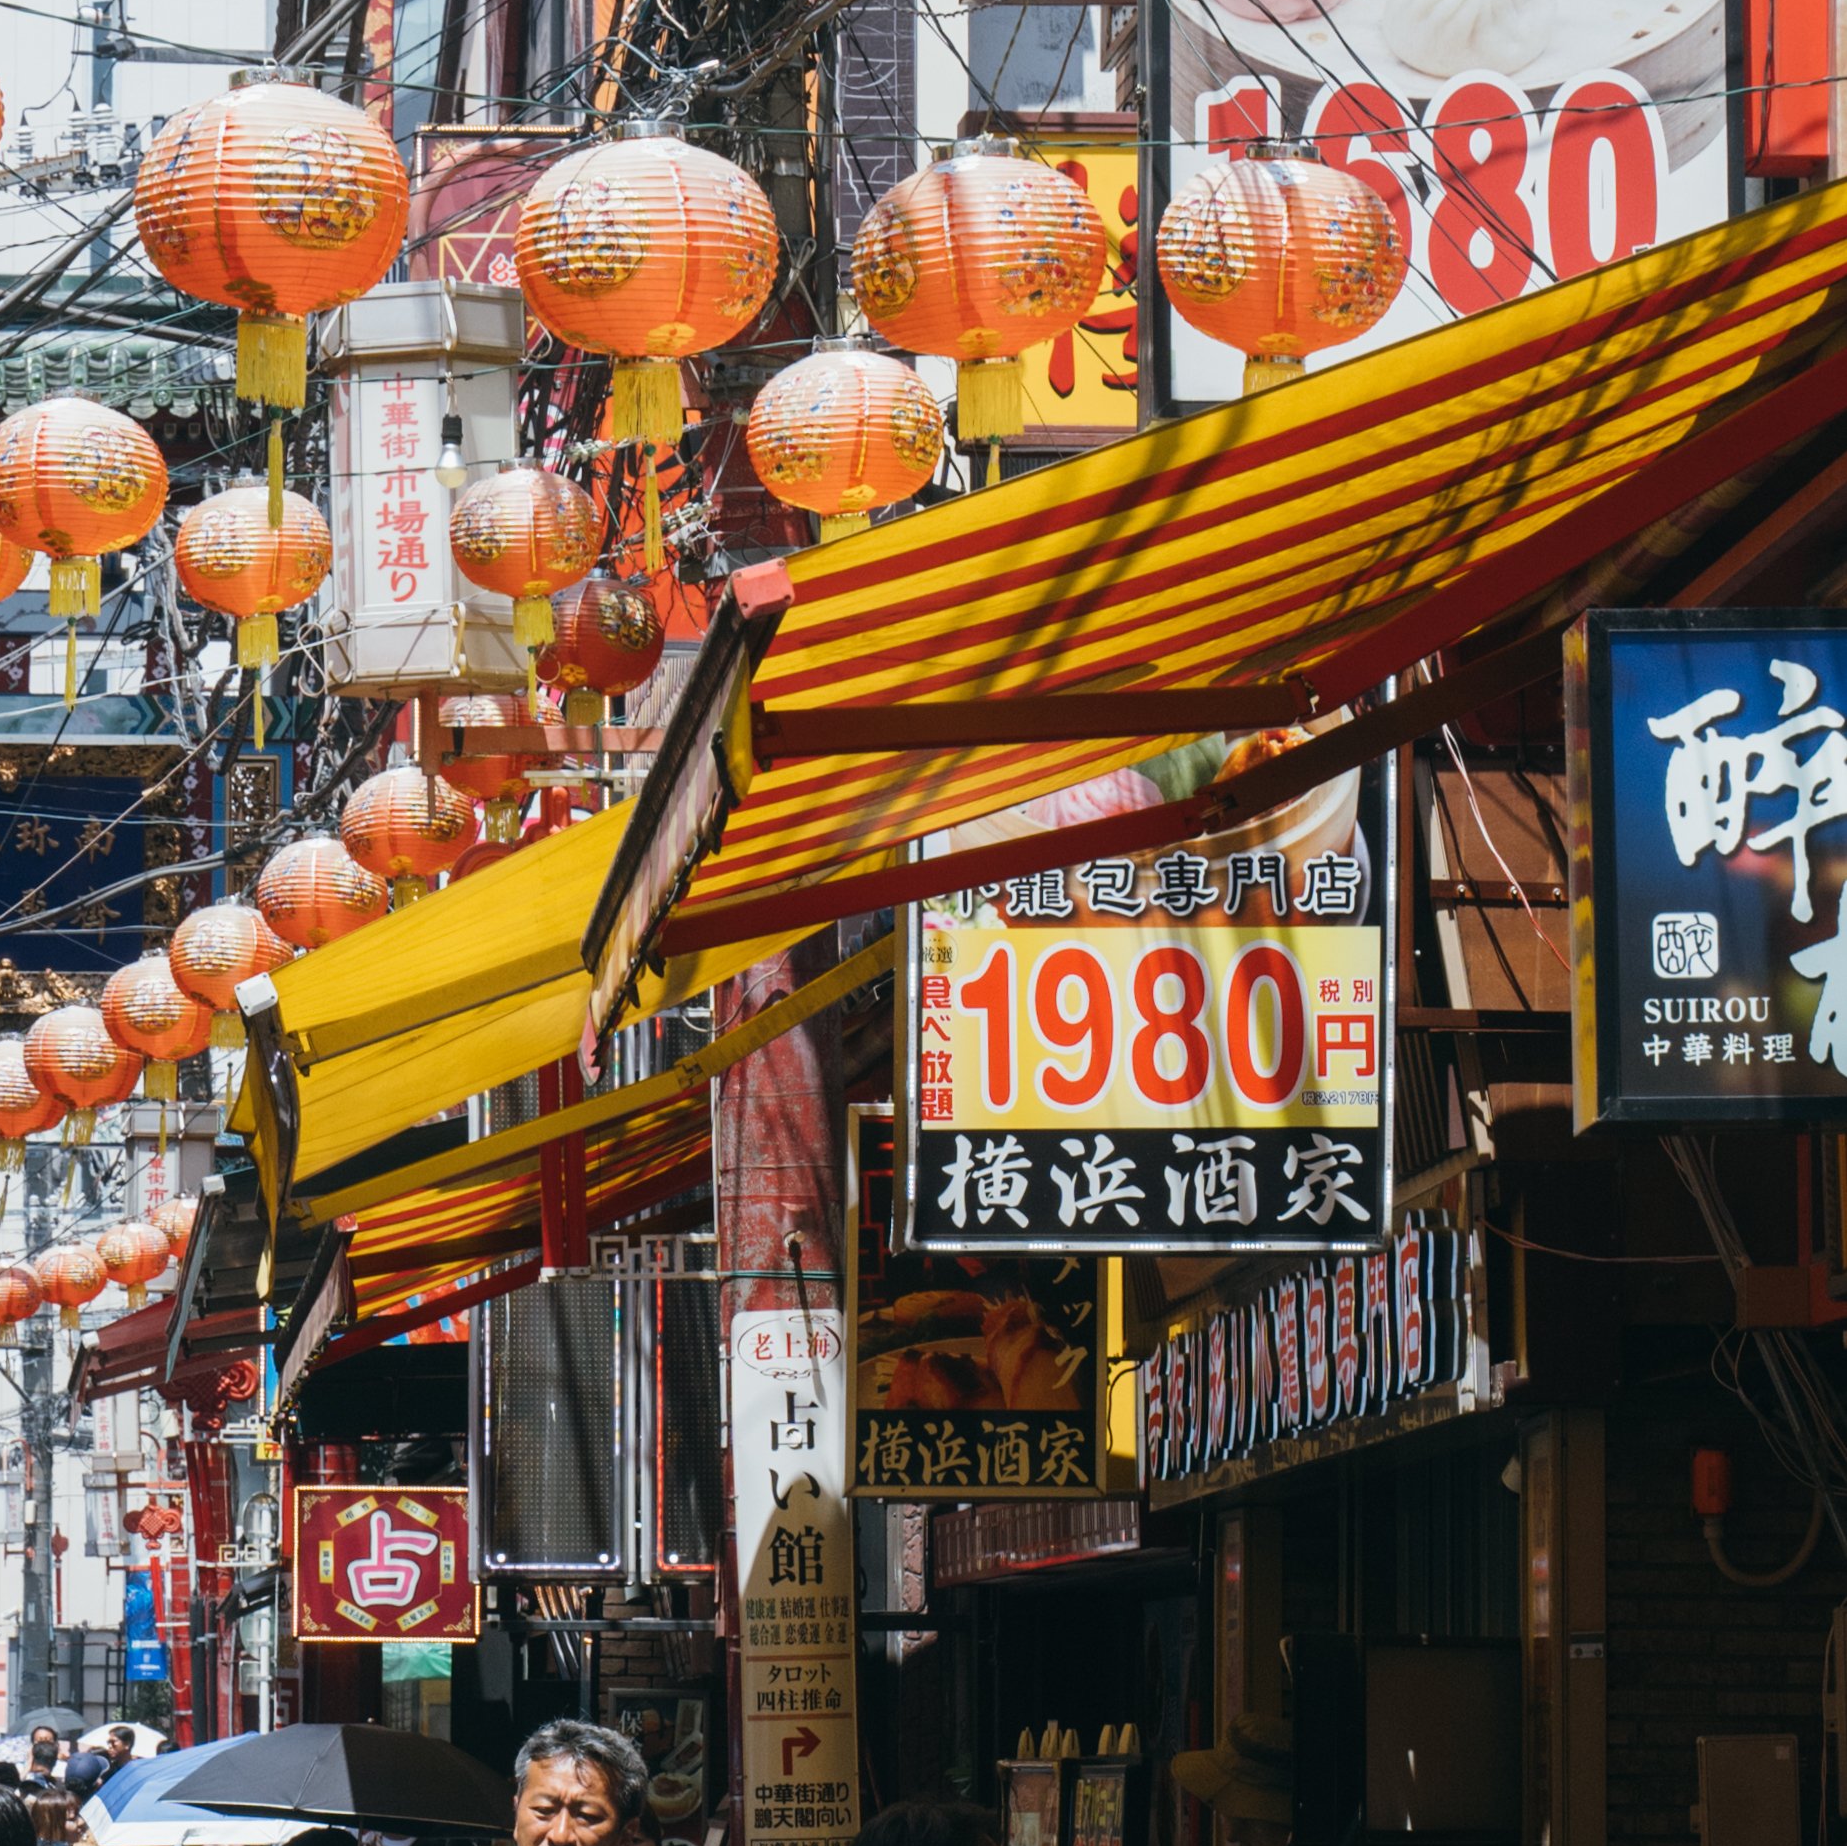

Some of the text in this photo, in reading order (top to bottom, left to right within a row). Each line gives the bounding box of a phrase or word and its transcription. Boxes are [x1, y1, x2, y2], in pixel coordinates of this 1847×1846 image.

[1318, 978, 1374, 1003] 税別
[1643, 996, 1771, 1025] SUIROU
[920, 975, 954, 1123] 食べ放題
[958, 943, 1308, 1110] 1980
[1315, 1014, 1376, 1079] 円
[1642, 1032, 1797, 1066] 中華料理
[937, 1132, 1372, 1230] 横浜酒家
[748, 1331, 832, 1363] 老上海
[859, 1419, 1089, 1486] 横浜酒家
[768, 1391, 826, 1587] 占い館
[347, 1510, 439, 1608] 占
[768, 1662, 832, 1684] タロット
[756, 1687, 842, 1712] 四柱推命
[755, 1782, 850, 1805] 中華街通り
